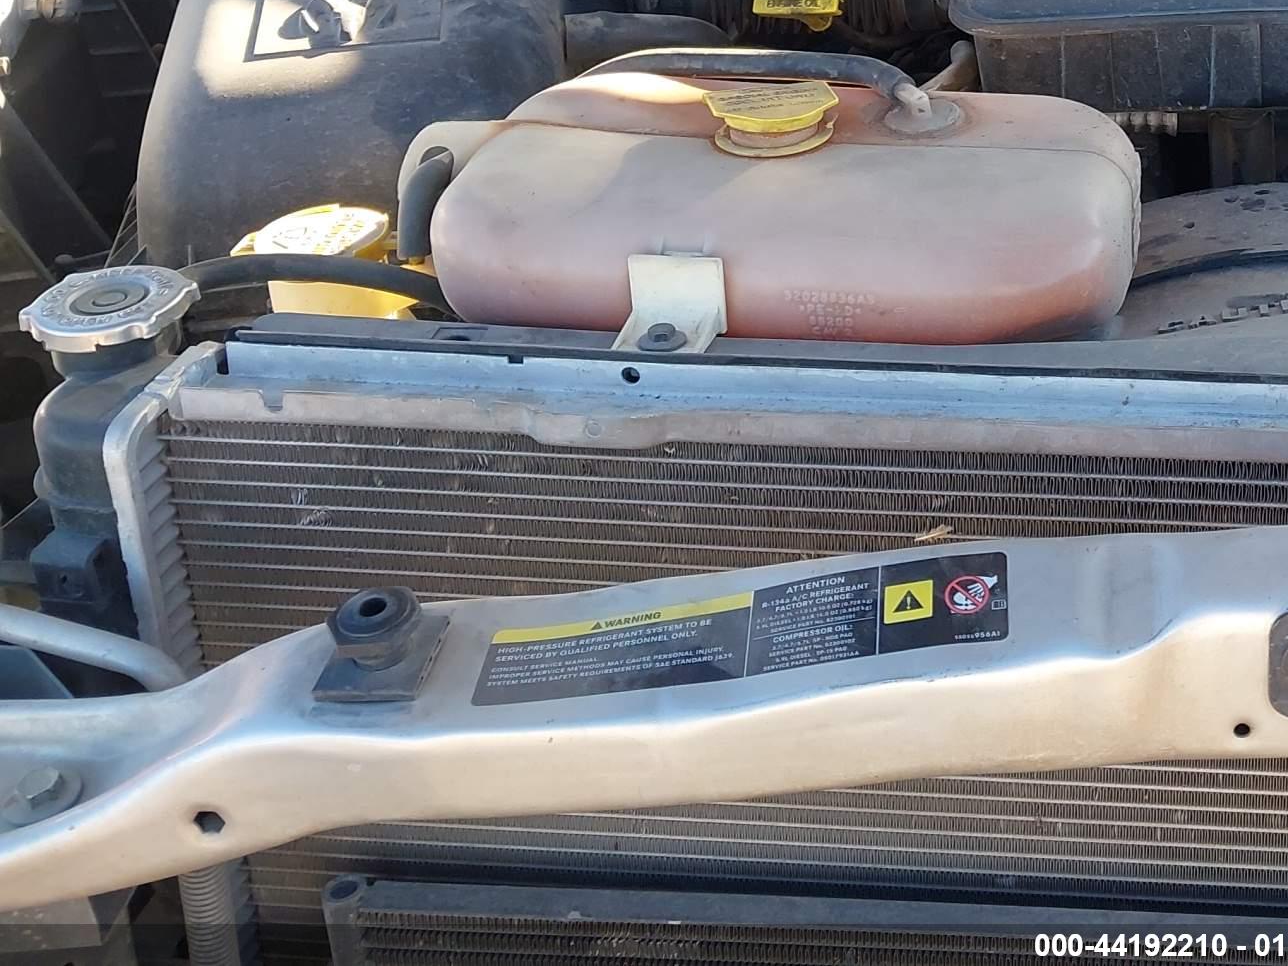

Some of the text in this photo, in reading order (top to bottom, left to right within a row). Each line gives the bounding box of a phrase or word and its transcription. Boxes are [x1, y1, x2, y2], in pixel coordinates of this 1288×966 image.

[786, 576, 845, 594] ATTENTION
[762, 583, 869, 608] R-134a A/C REFRIGERANT
[775, 592, 855, 613] FACTORY CHARGE:
[605, 611, 662, 628] WARNING
[770, 624, 792, 634] SERVICE
[793, 621, 810, 629] PART
[497, 618, 712, 654] HIGH-PRESSURE REFRIGERANT SYSTEM TO BE
[773, 624, 854, 643] COMPRESSOR OIL:
[495, 630, 698, 662] SERVICED BY QUALIFIED PERSONNEL ONLY.
[769, 648, 795, 658] SERVICE
[795, 644, 812, 653] PART
[789, 651, 811, 660] DIESEL
[487, 678, 519, 687] SYSTEM
[520, 676, 546, 684] MEETS
[548, 673, 578, 682] SAFETY
[579, 664, 641, 677] REQUIREMENTS
[642, 662, 653, 670] OF
[655, 660, 670, 668] SAE
[671, 655, 713, 666] STANDARD
[488, 671, 530, 680] IMPROPER
[532, 668, 565, 676] SERVICE
[566, 662, 605, 673] METHODS
[625, 655, 652, 664] CAUSE
[653, 650, 694, 660] PERSONAL
[491, 664, 529, 673] CONSULT
[529, 661, 562, 670] SERVICE
[763, 661, 789, 672] SERVICE
[790, 658, 808, 667] PART
